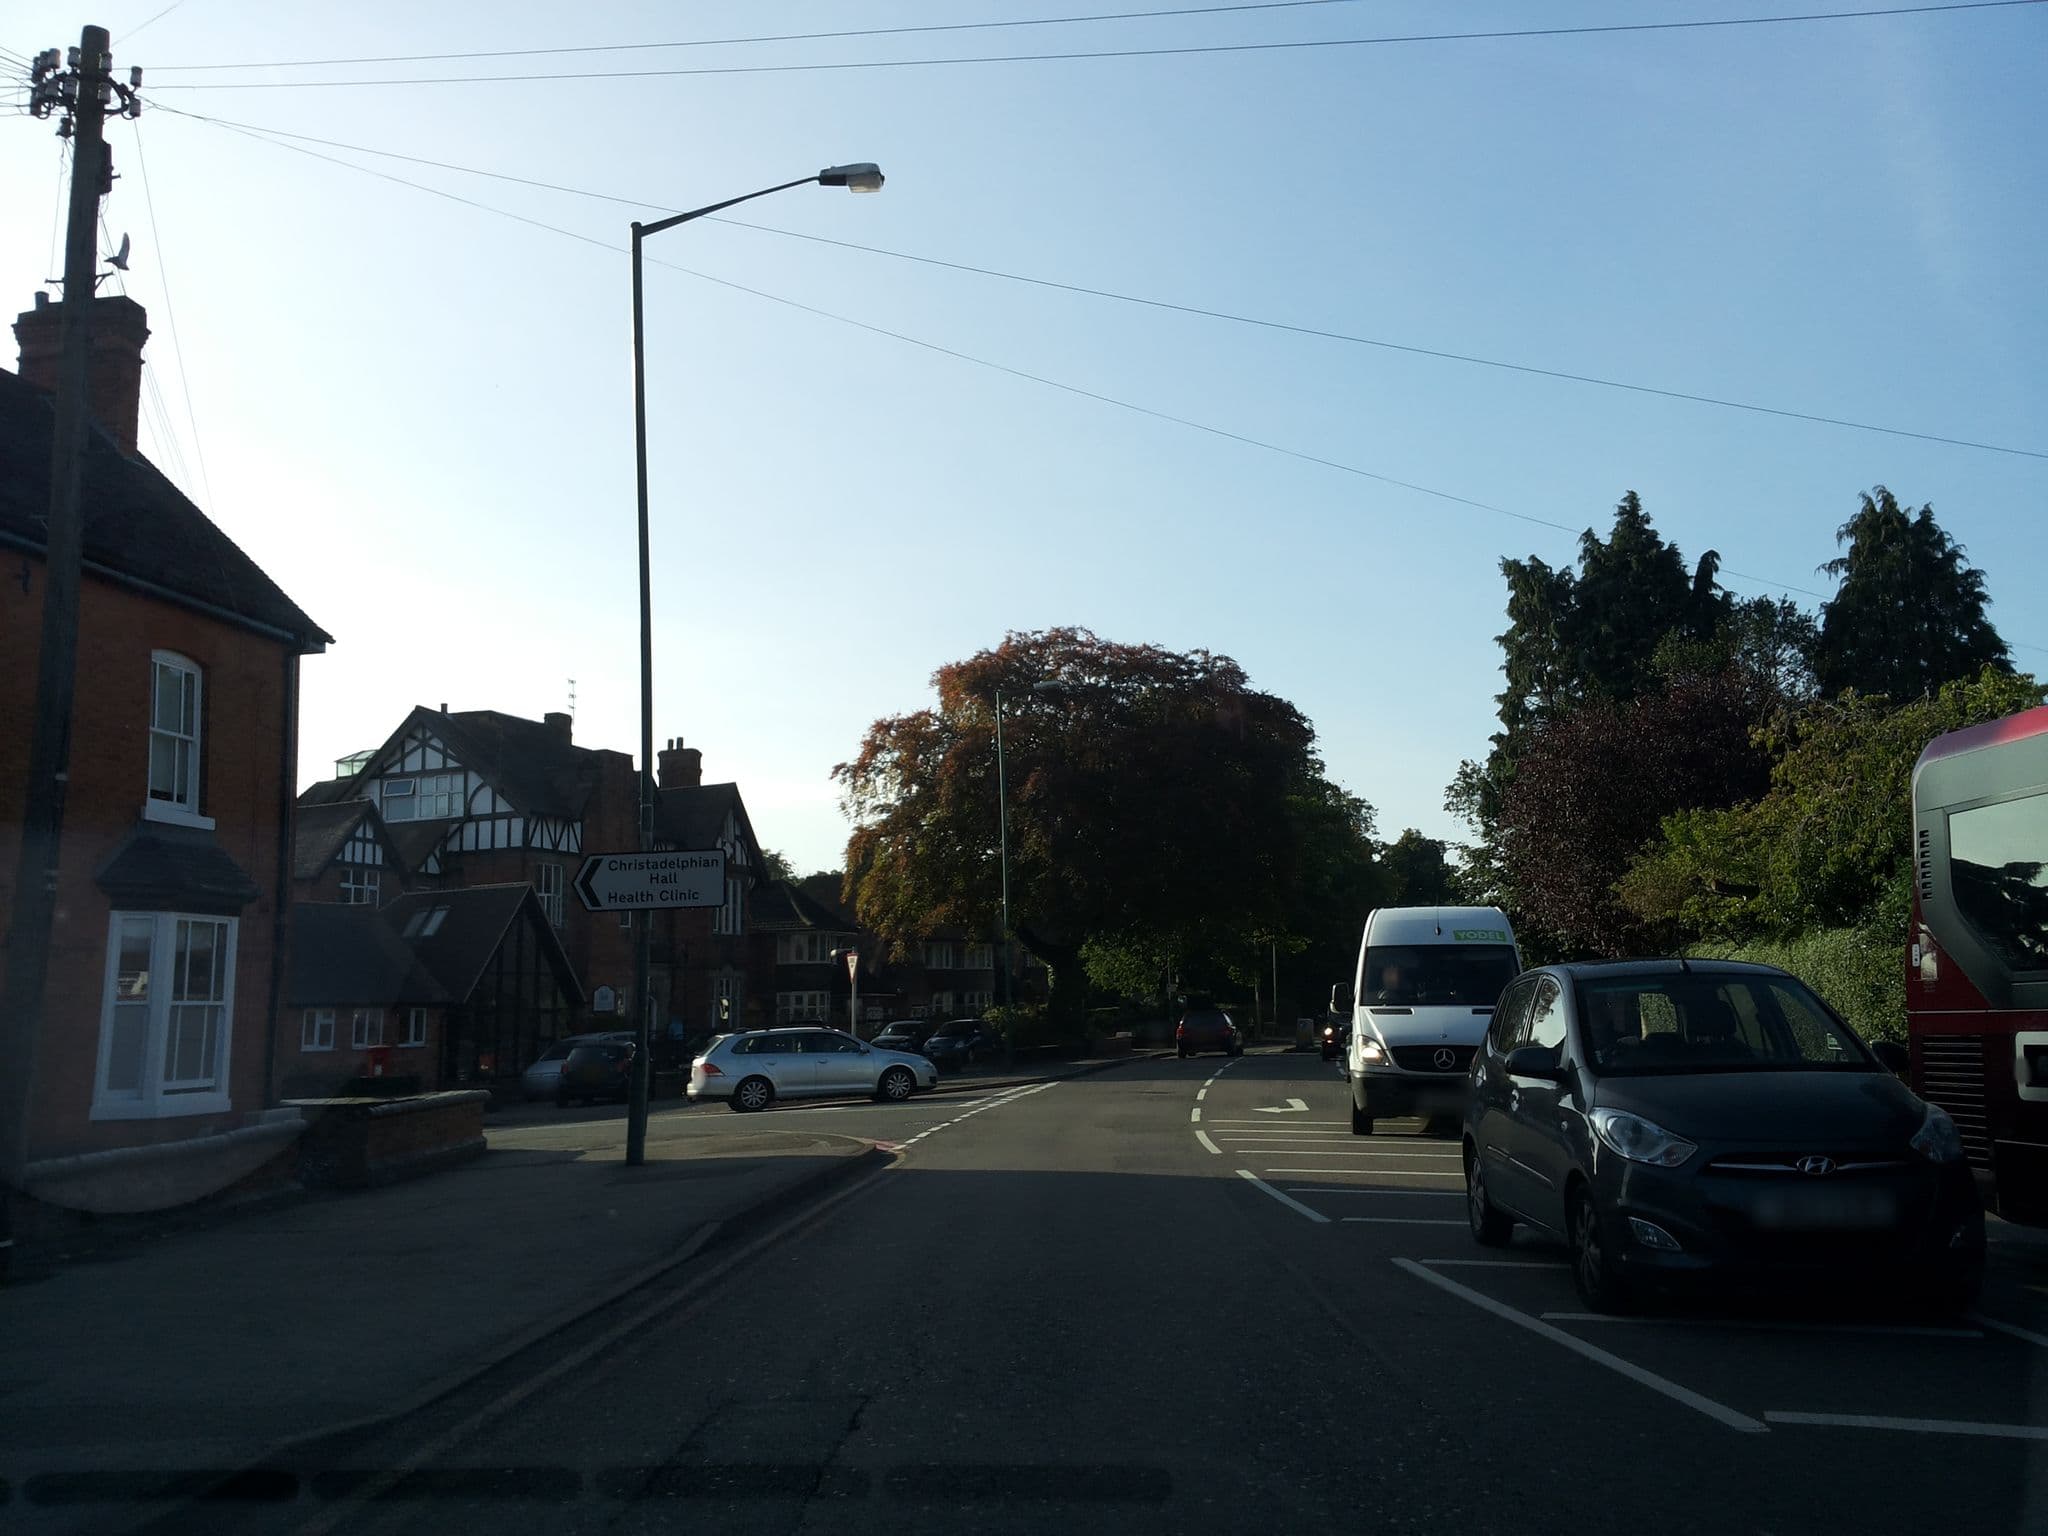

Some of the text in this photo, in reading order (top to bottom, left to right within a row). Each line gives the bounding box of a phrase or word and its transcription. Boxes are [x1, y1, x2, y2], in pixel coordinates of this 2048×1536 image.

[608, 857, 718, 871] Christadelphian
[650, 872, 677, 884] Hall
[608, 889, 699, 903] Health Clinic
[1457, 931, 1503, 941] YODEL
